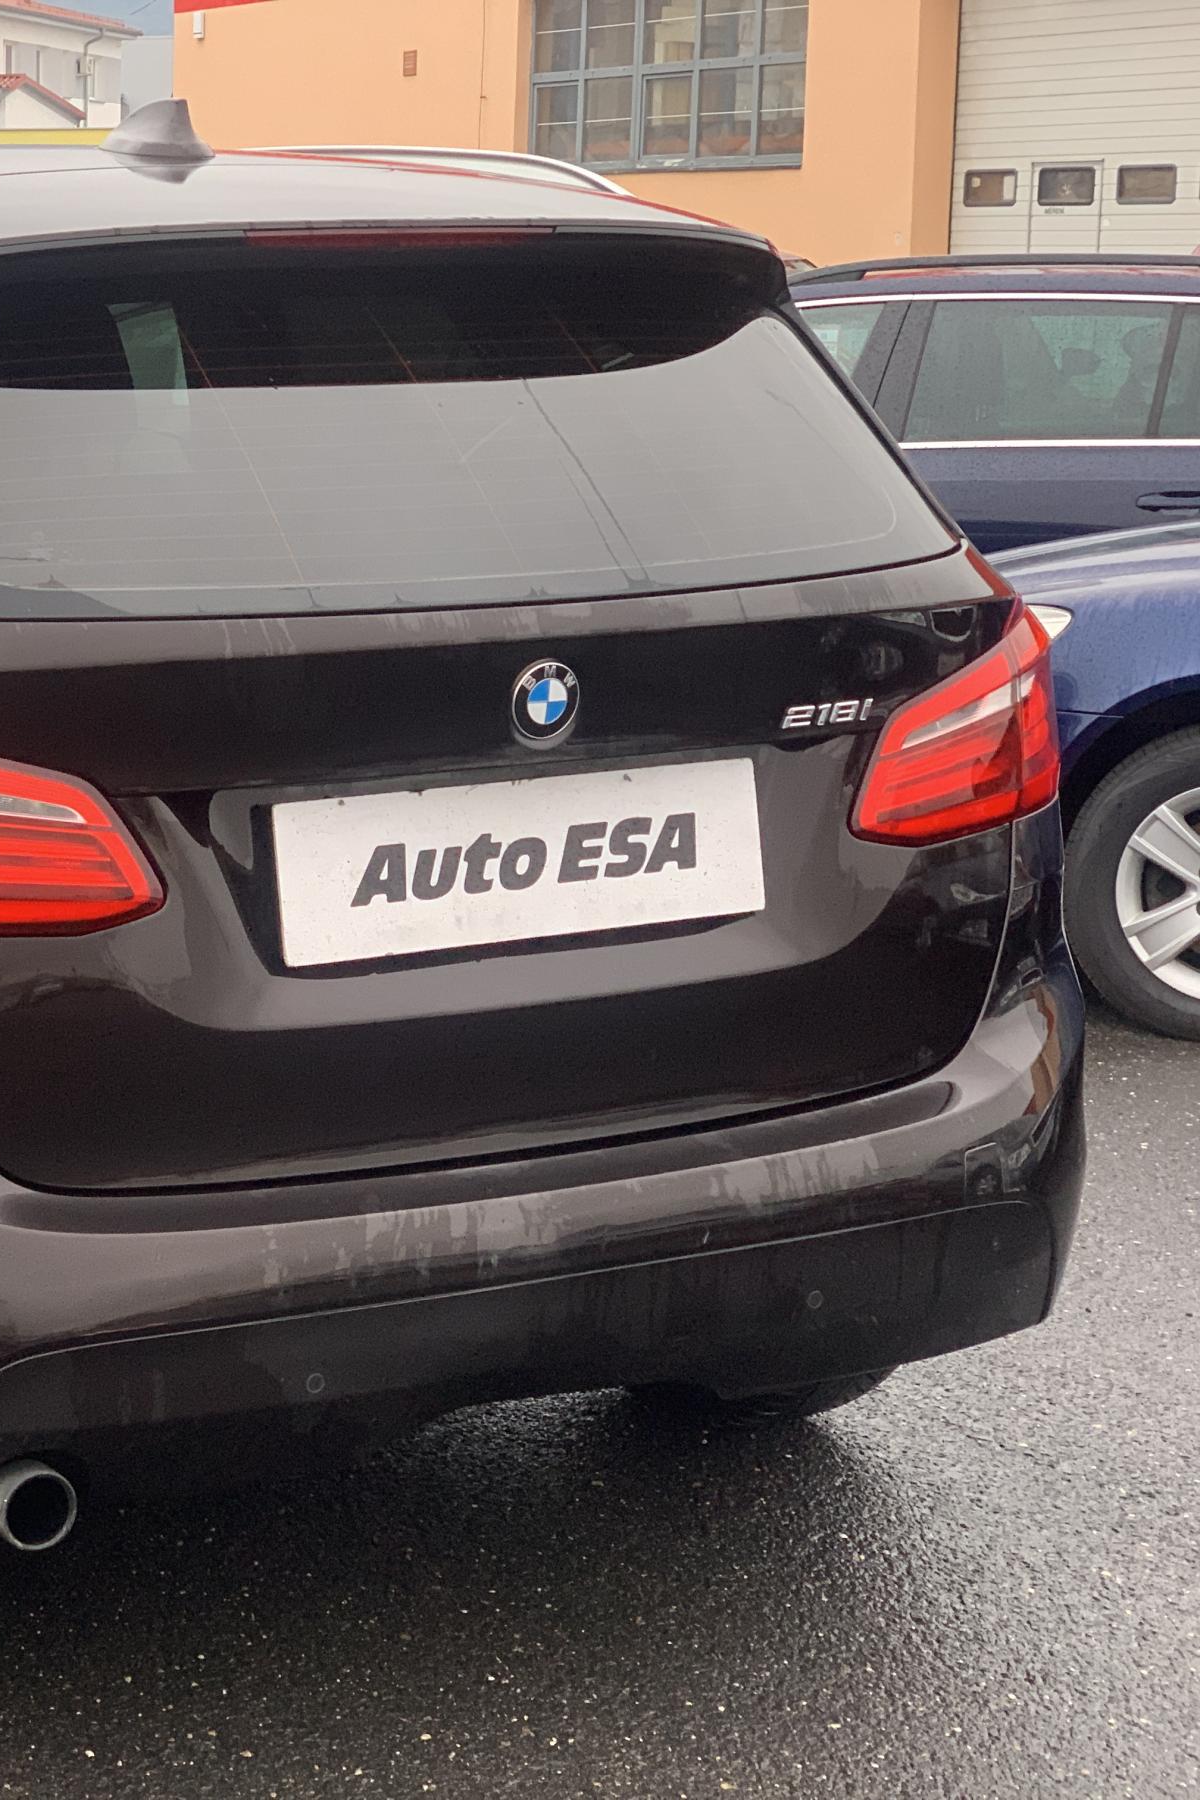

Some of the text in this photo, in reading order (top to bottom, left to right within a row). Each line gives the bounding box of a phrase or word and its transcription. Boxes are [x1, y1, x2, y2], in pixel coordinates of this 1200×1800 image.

[522, 665, 576, 690] BMW
[781, 698, 874, 729] 218i
[350, 812, 697, 907] Auto ESA
